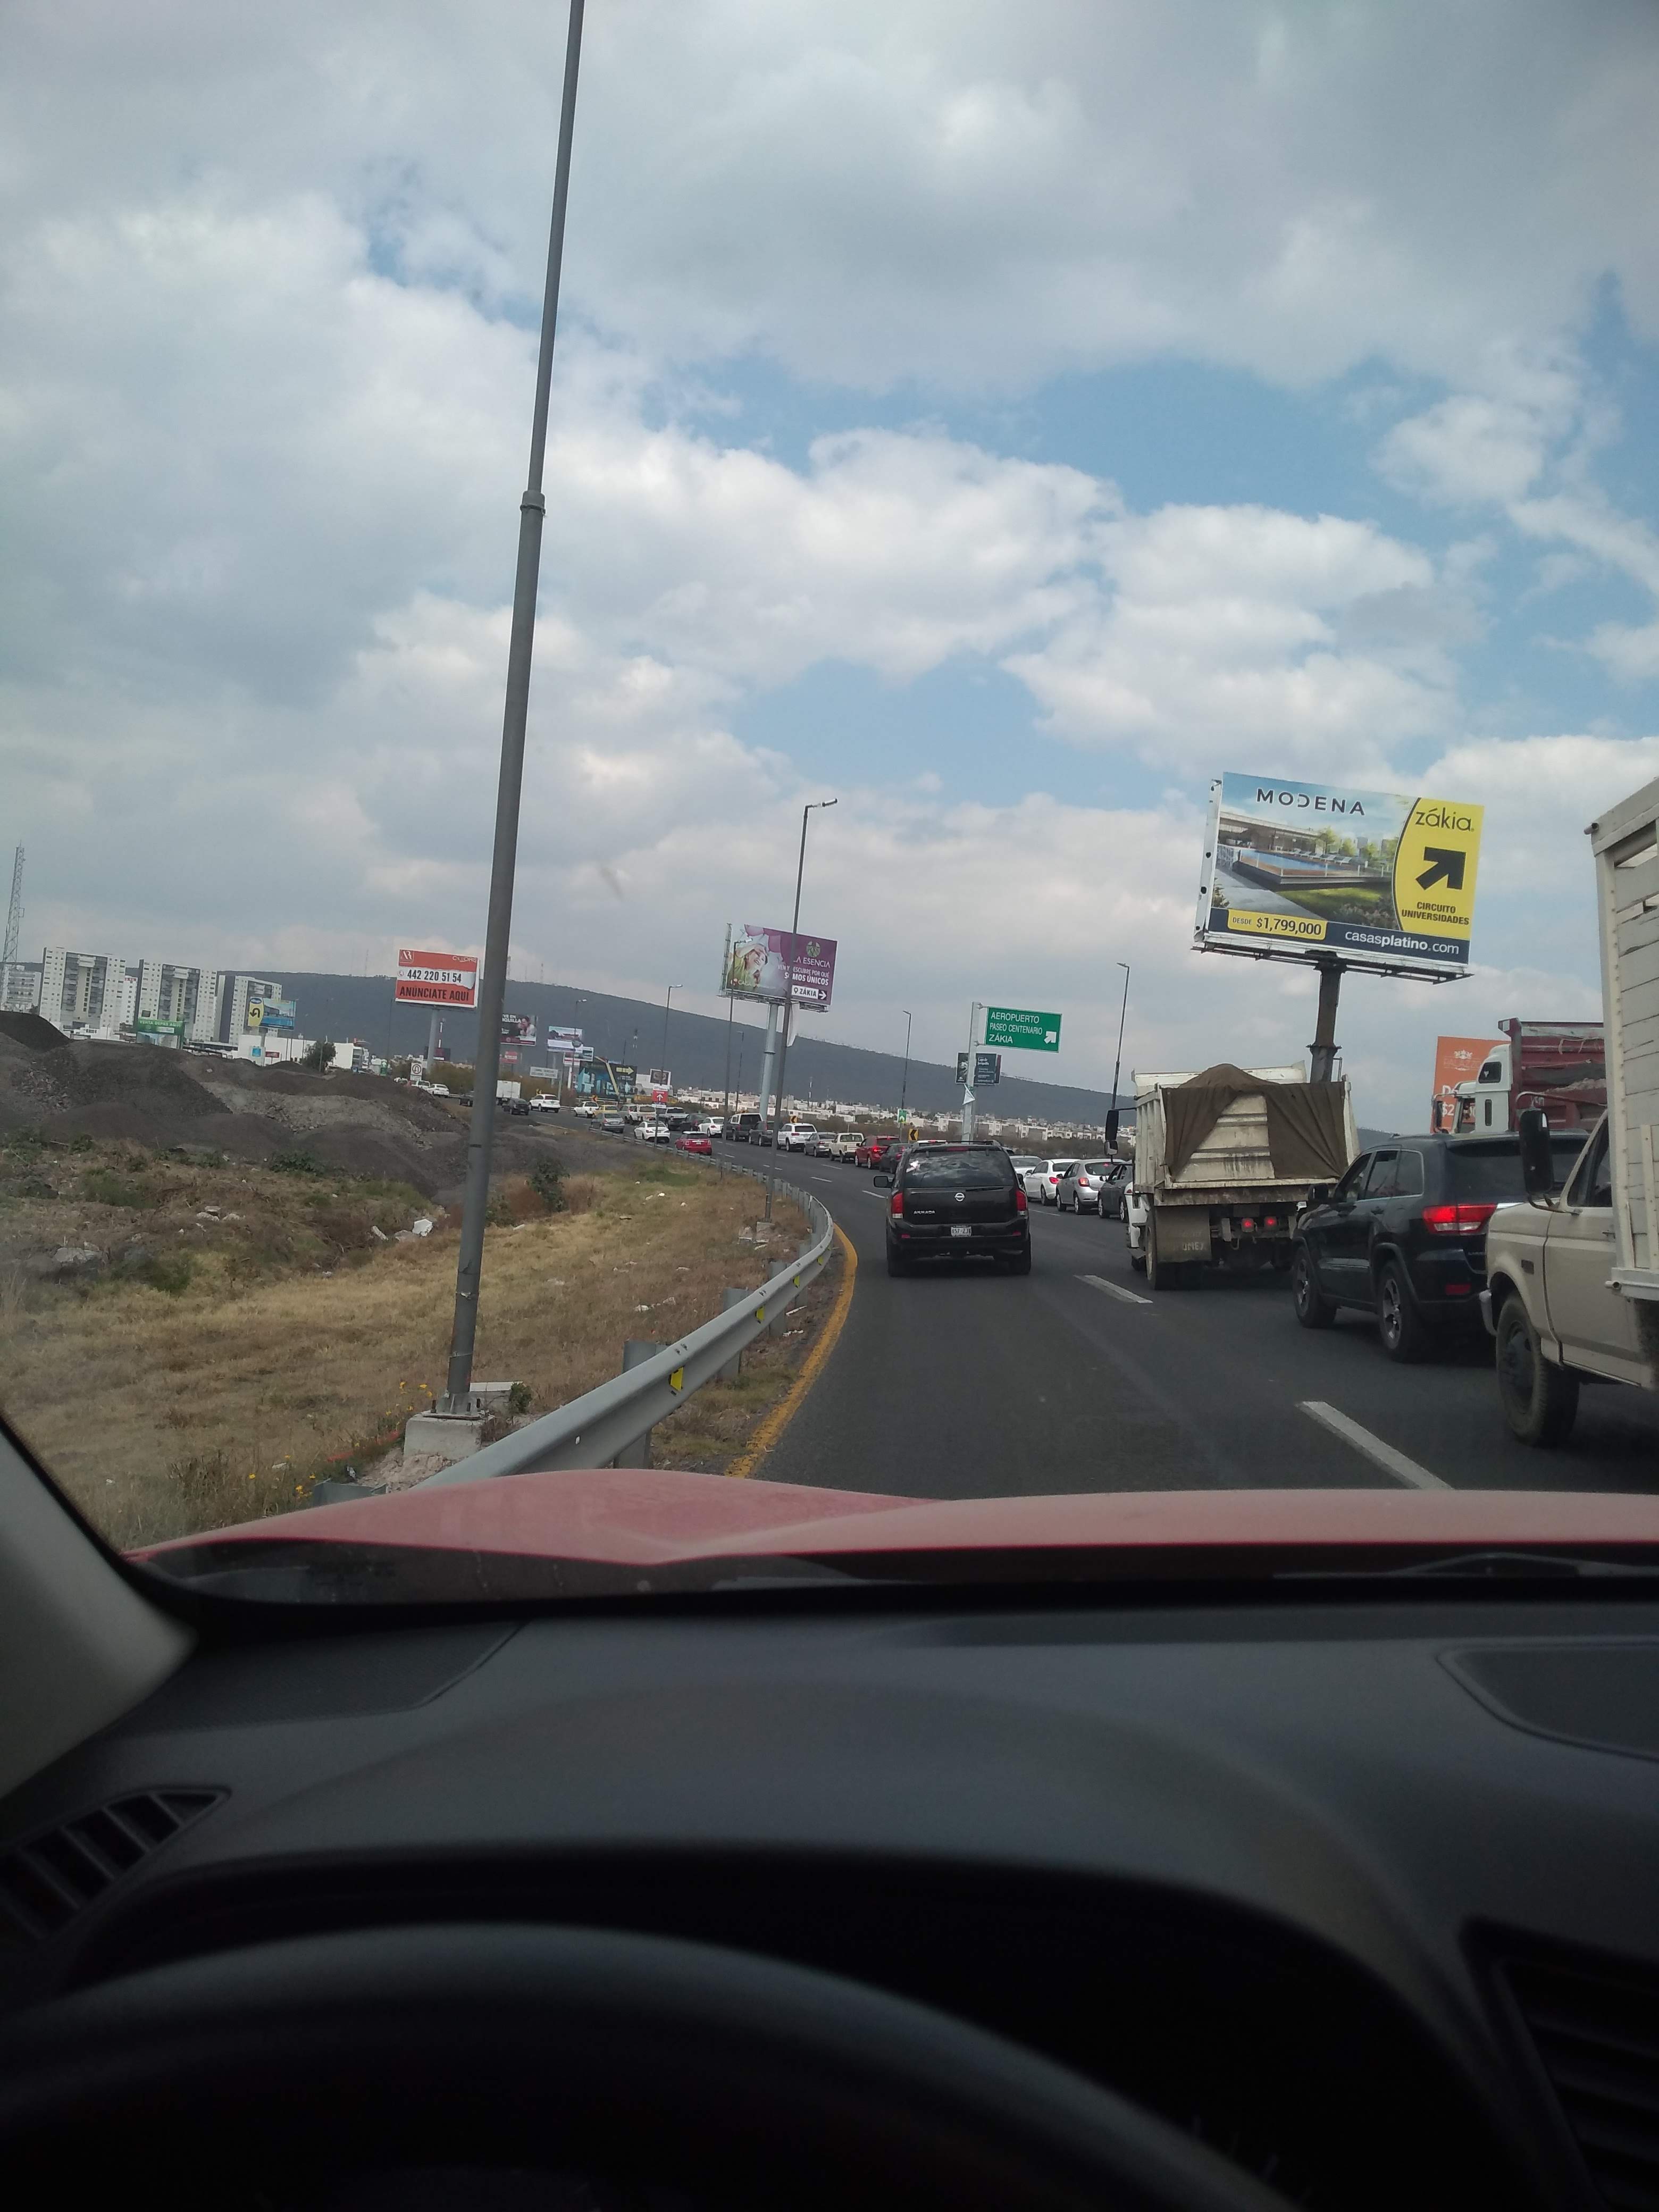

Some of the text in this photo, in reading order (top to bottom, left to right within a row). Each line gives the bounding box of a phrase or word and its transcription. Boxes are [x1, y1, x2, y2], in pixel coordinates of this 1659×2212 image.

[1256, 788, 1365, 816] MODENA
[1415, 807, 1472, 832] zákia
[1417, 902, 1456, 914] CIRCUITO
[1401, 910, 1470, 925] UNIVERSIDADES
[1232, 917, 1322, 936] DESDE $1,799,000
[1345, 930, 1460, 954] casasplatino.com
[803, 957, 831, 968] ESENCIA
[407, 969, 462, 983] 442 220 51 54
[784, 972, 829, 986] SMOS ÚNICOS
[799, 987, 817, 997] ZÁKIA
[991, 1011, 1040, 1024] AEROPUERTO
[990, 1023, 1043, 1035] PASEO CENTENARIO
[988, 1033, 1013, 1044] ZÁKIA
